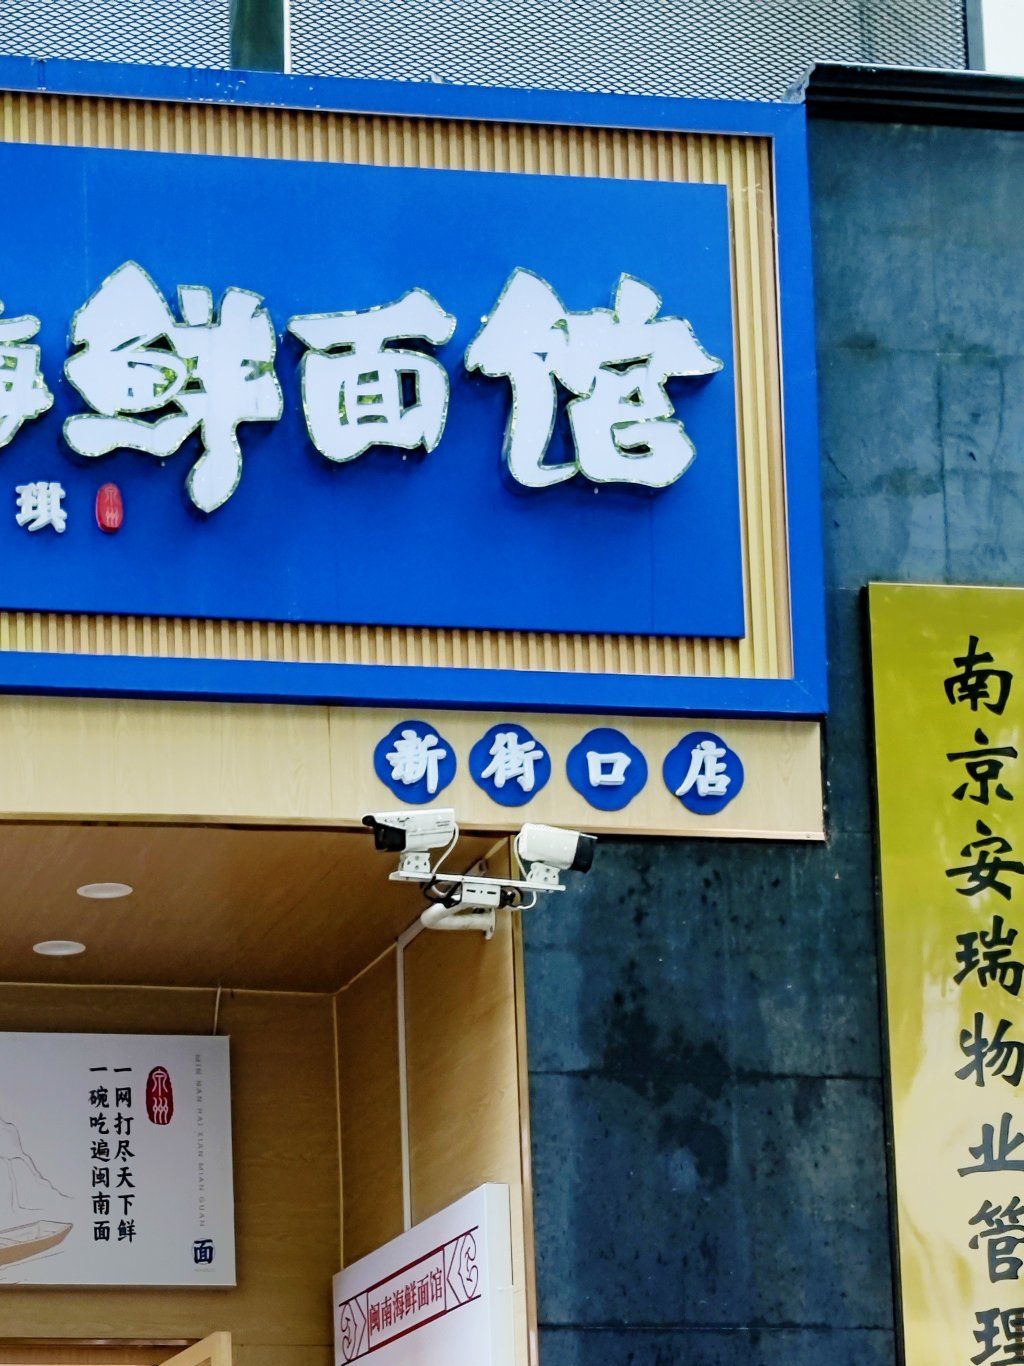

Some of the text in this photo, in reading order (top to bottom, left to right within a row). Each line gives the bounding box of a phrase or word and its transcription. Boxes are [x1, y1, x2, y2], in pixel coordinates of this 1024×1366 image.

[385, 728, 732, 798] 新街口店
[87, 1066, 112, 1243] 一碗吃遍闽南面
[113, 1066, 137, 1243] 一网打尽天下鲜
[193, 1238, 214, 1265] 面
[368, 1266, 444, 1335] 闽南海鲜面馆
